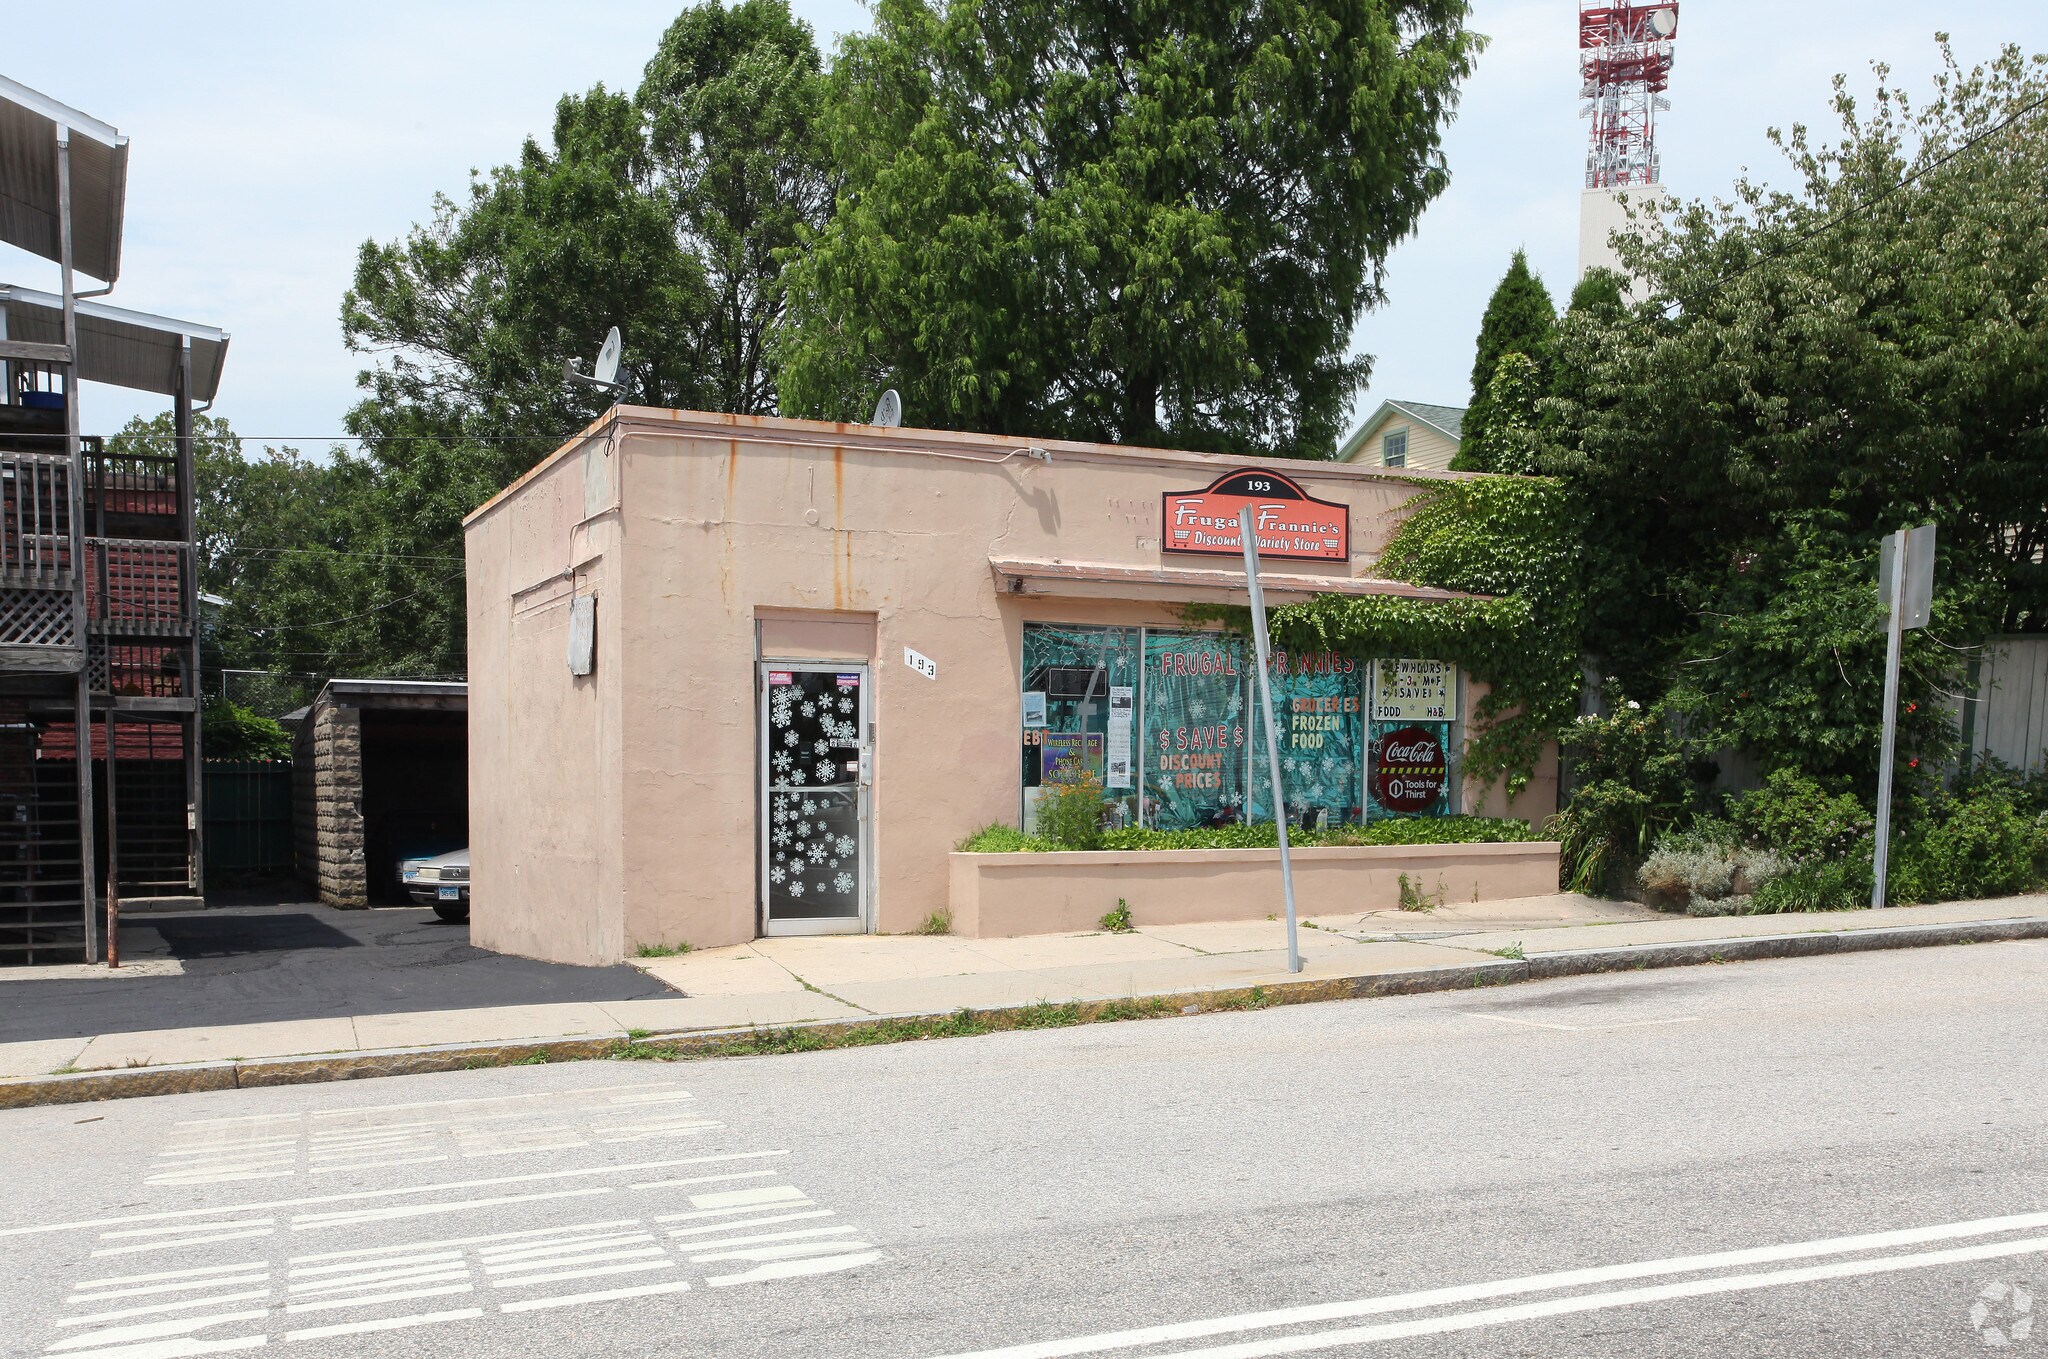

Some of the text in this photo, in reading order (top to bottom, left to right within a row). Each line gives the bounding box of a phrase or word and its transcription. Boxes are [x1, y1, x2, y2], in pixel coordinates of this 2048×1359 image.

[1247, 480, 1271, 492] 193
[1174, 499, 1339, 535] Fruga Frannie's
[1194, 531, 1320, 552] Discount Variety Store
[909, 654, 934, 676] 193
[1161, 651, 1237, 677] FRUGAL
[1292, 696, 1360, 713] GROCERES
[1378, 706, 1443, 718] FOOD H&B
[1292, 715, 1340, 731] FROZEN
[1023, 729, 1050, 746] EBT
[1071, 738, 1098, 747] RECRGE
[1159, 724, 1244, 751] $ SAVE $
[1291, 733, 1324, 749] FOOD
[1068, 747, 1076, 756] &
[1385, 741, 1437, 762] Coca-Cola
[1160, 753, 1223, 771] DISCOUNT
[1175, 771, 1222, 788] PRICES
[1405, 780, 1437, 789] Tools for
[1405, 790, 1426, 799] Thirst
